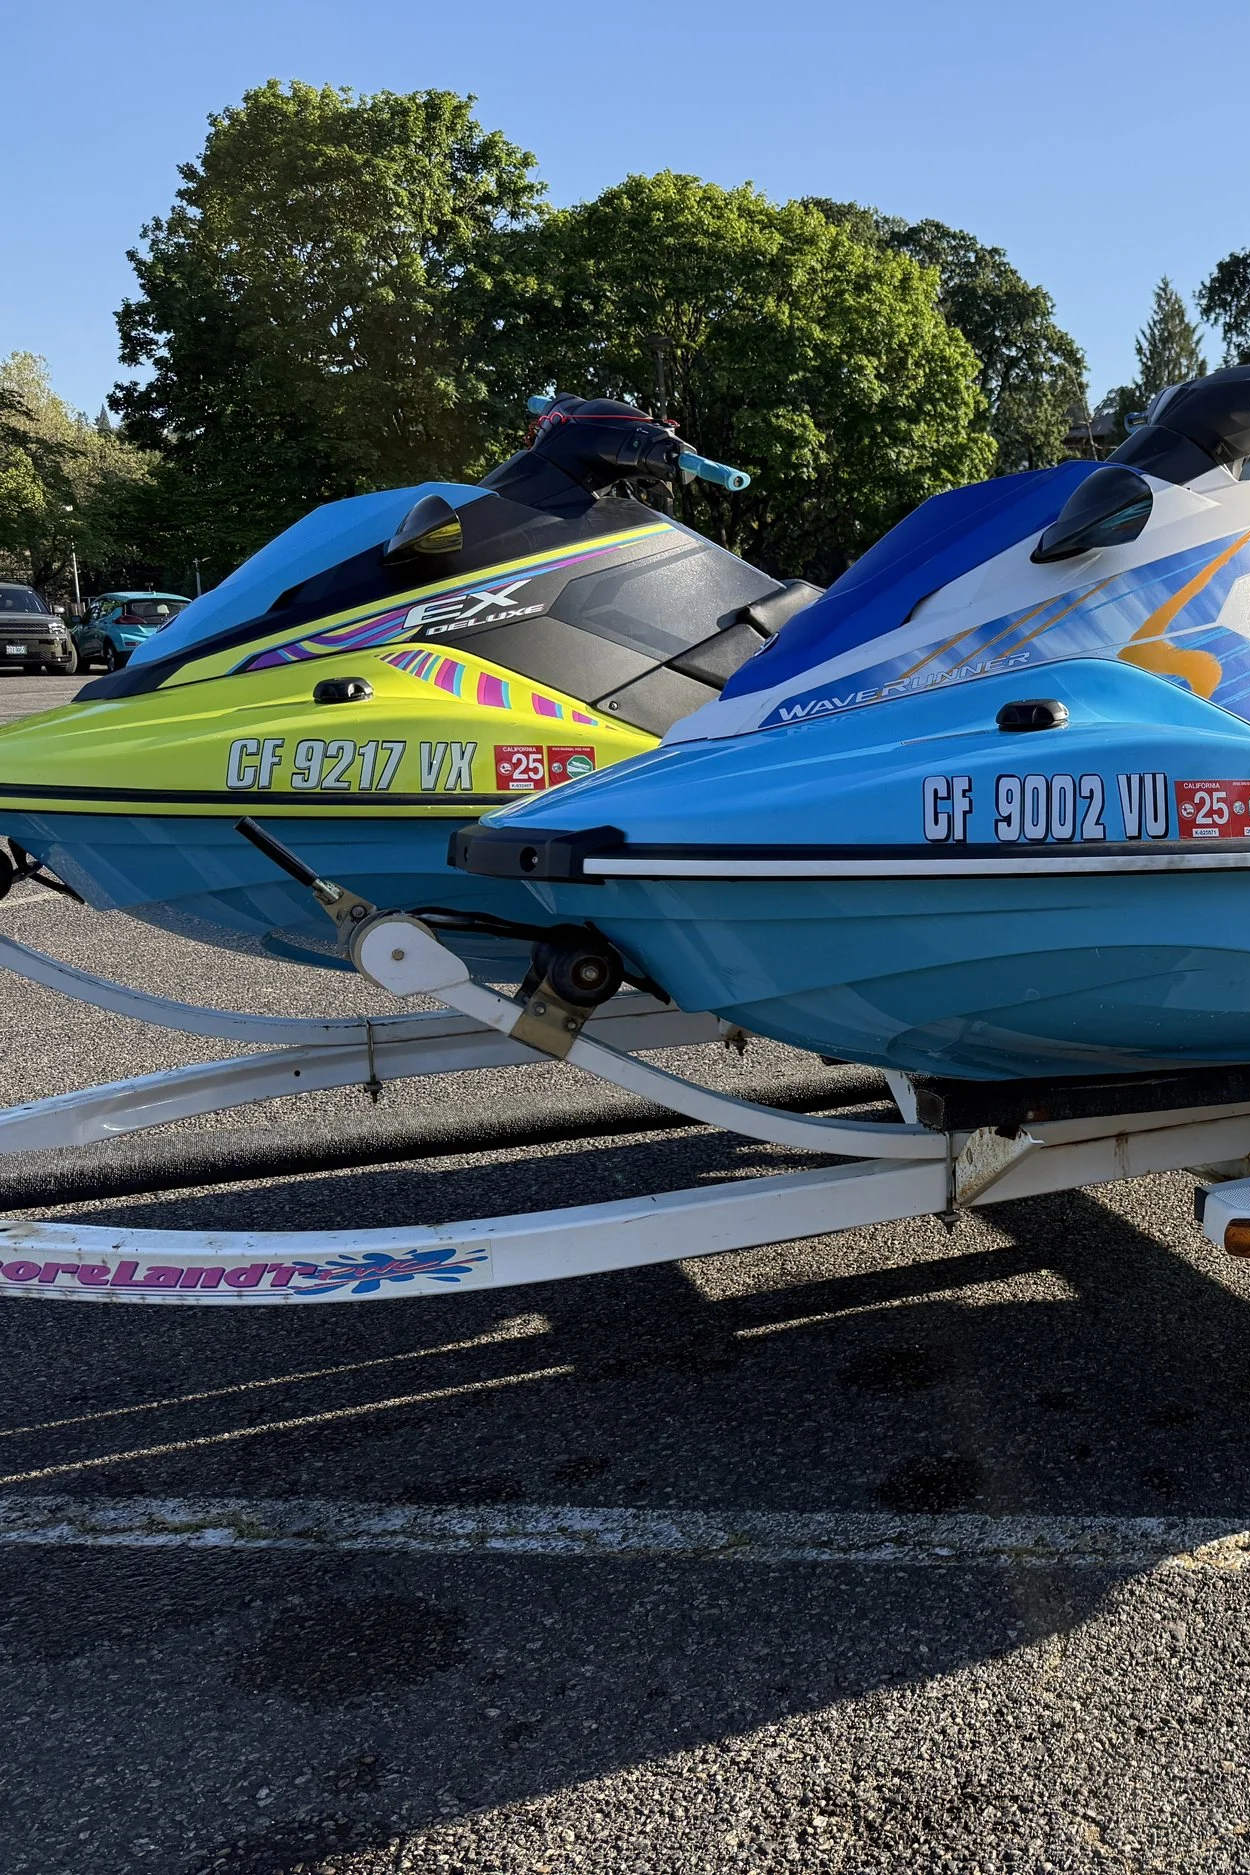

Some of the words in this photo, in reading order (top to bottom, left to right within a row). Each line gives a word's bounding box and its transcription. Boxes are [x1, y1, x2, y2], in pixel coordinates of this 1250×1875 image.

[402, 578, 532, 629] EX
[425, 603, 545, 636] DELUXE
[778, 651, 1031, 721] WAVERUNNER
[226, 738, 285, 791] CF
[291, 739, 406, 791] 9217
[419, 741, 477, 791] VX
[511, 753, 544, 780] 25
[923, 775, 973, 843] CF
[994, 773, 1106, 842] 9002
[1116, 773, 1169, 840] VU
[1194, 790, 1229, 825] 25
[0, 1260, 318, 1288] oreLand'r
